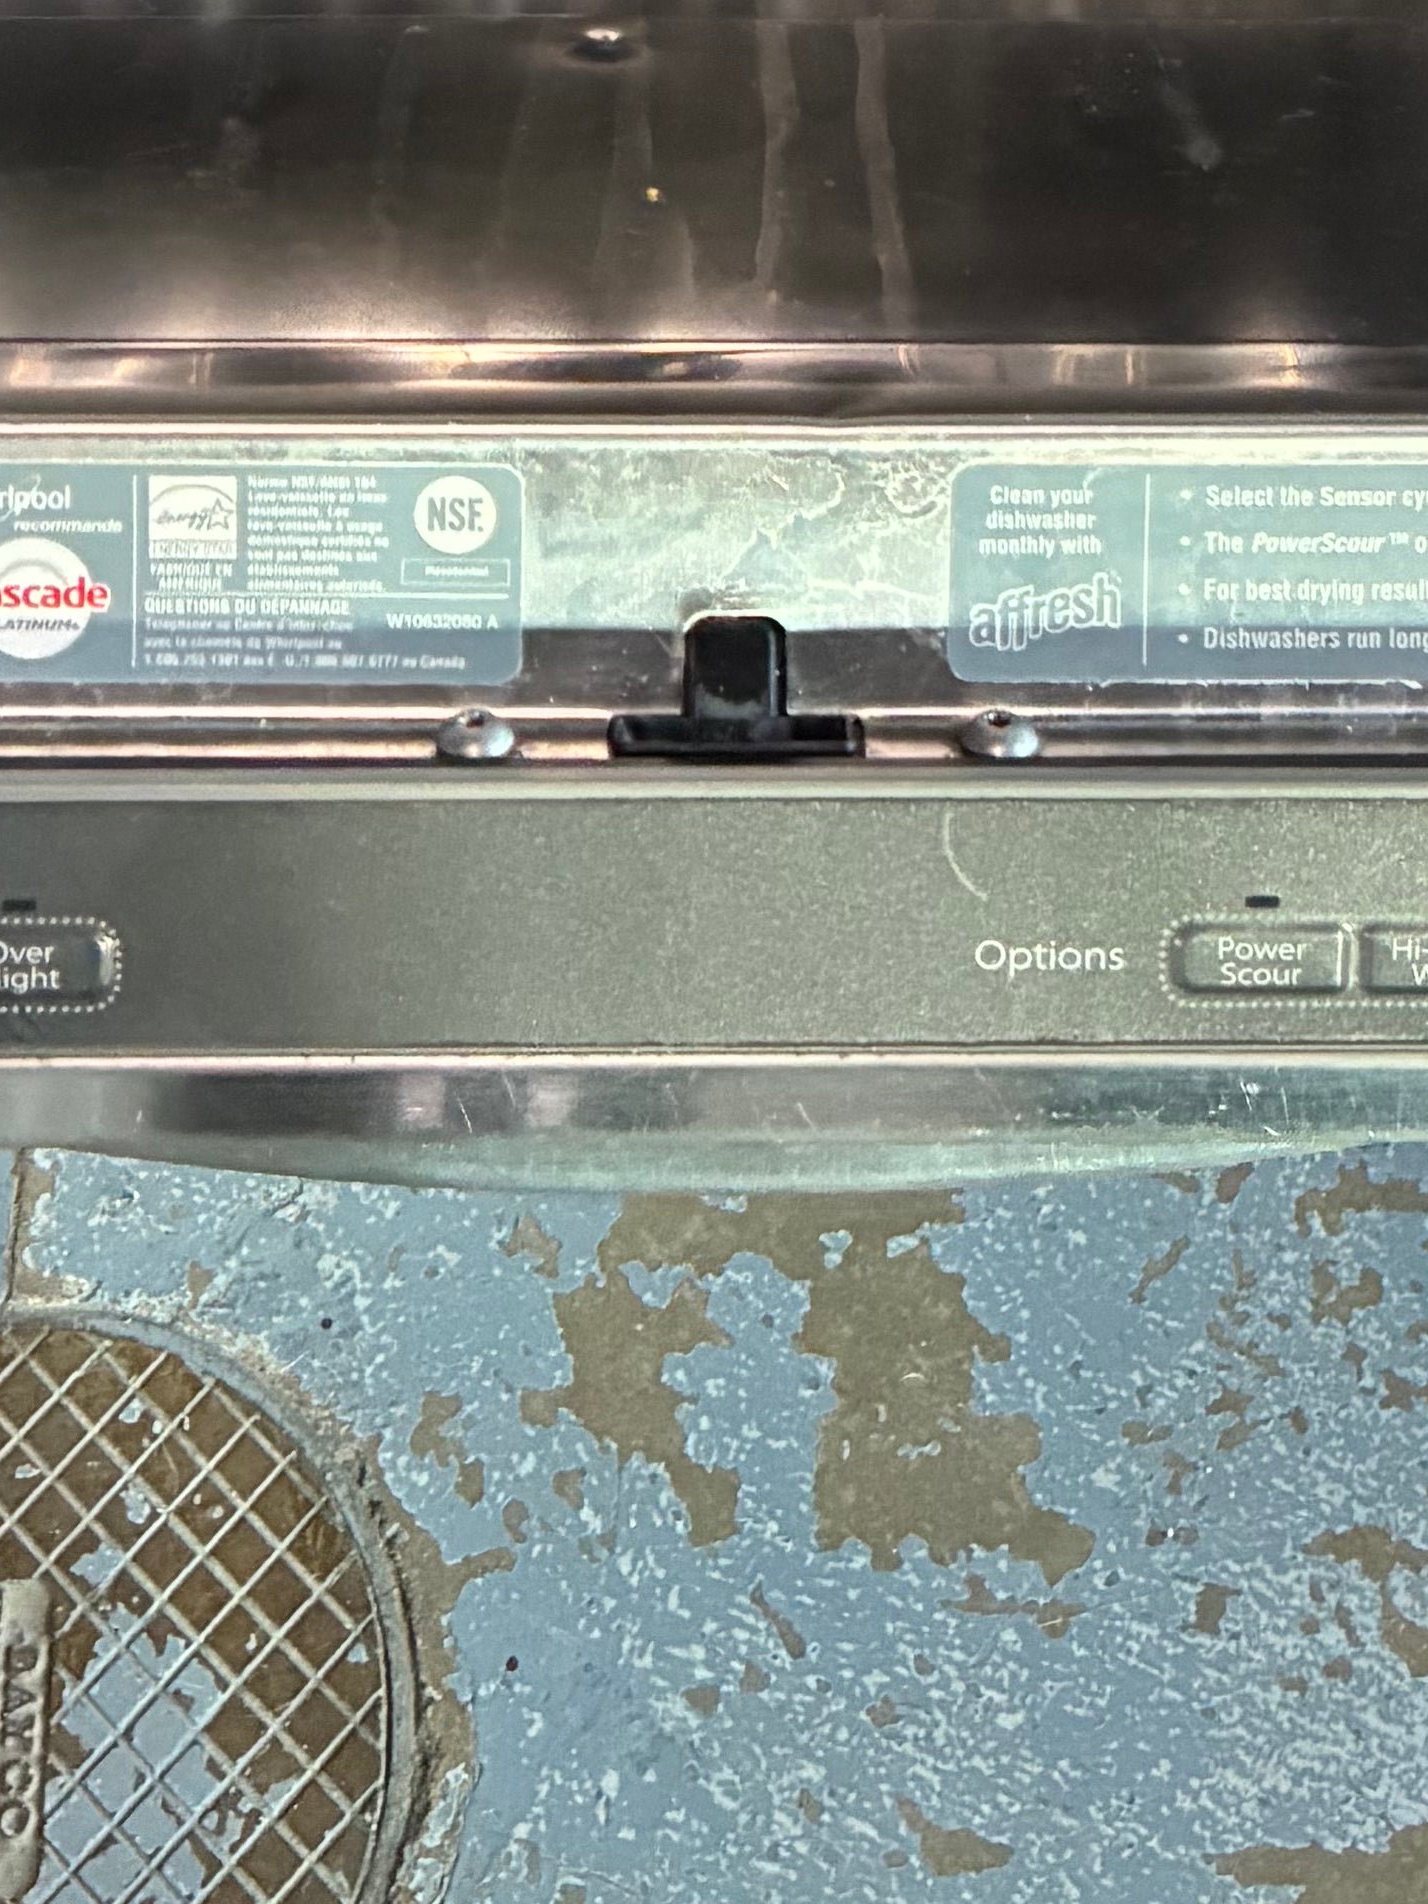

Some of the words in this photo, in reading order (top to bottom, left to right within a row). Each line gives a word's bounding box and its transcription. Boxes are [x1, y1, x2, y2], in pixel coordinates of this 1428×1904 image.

[990, 485, 1044, 505] Clean
[1051, 488, 1093, 509] your
[1205, 485, 1274, 508] Select
[1280, 485, 1313, 508] the
[1319, 485, 1396, 508] Sensor
[13, 518, 123, 533] recommande
[985, 510, 1097, 530] dishwasher
[978, 535, 1054, 559] monthly
[1060, 534, 1102, 554] with
[1203, 533, 1244, 555] The
[1251, 533, 1408, 555] PowerScour™
[1204, 579, 1239, 601] For
[1245, 579, 1291, 601] best
[1297, 579, 1364, 606] drying
[969, 572, 1122, 651] affresh
[1204, 628, 1340, 650] Dishwashers
[1348, 633, 1381, 650] run
[974, 939, 1125, 978] Options
[1217, 936, 1307, 961] Power
[1220, 962, 1302, 986] Scour
